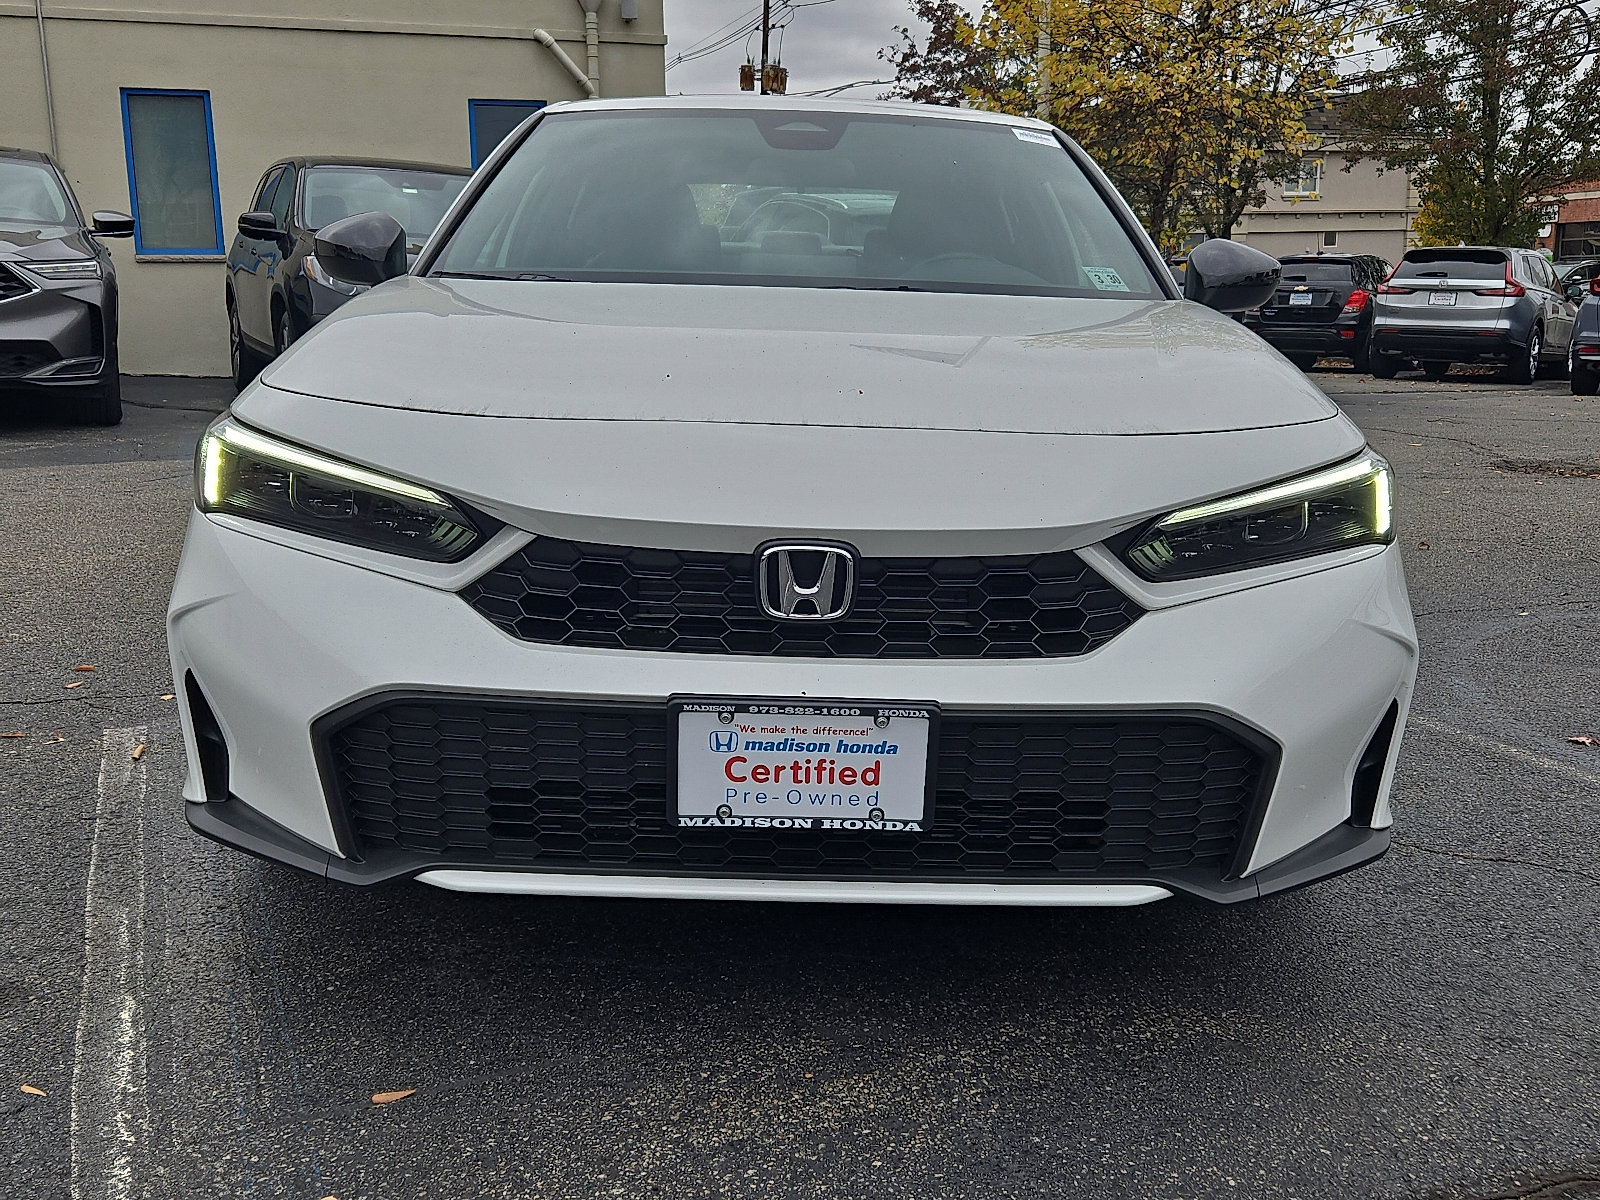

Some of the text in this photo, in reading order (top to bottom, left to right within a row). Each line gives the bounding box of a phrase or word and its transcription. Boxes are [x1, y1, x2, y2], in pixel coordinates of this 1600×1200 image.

[1094, 274, 1121, 284] 3 30
[683, 704, 735, 712] MADISON
[749, 705, 861, 716] 973-822-1600
[878, 709, 930, 718] HONDA
[760, 725, 786, 734] make
[791, 726, 808, 734] the
[744, 738, 898, 754] madison honda
[724, 756, 881, 786] Certified
[725, 788, 879, 807] Pre-Owned
[678, 817, 923, 831] MADISON HONDA
